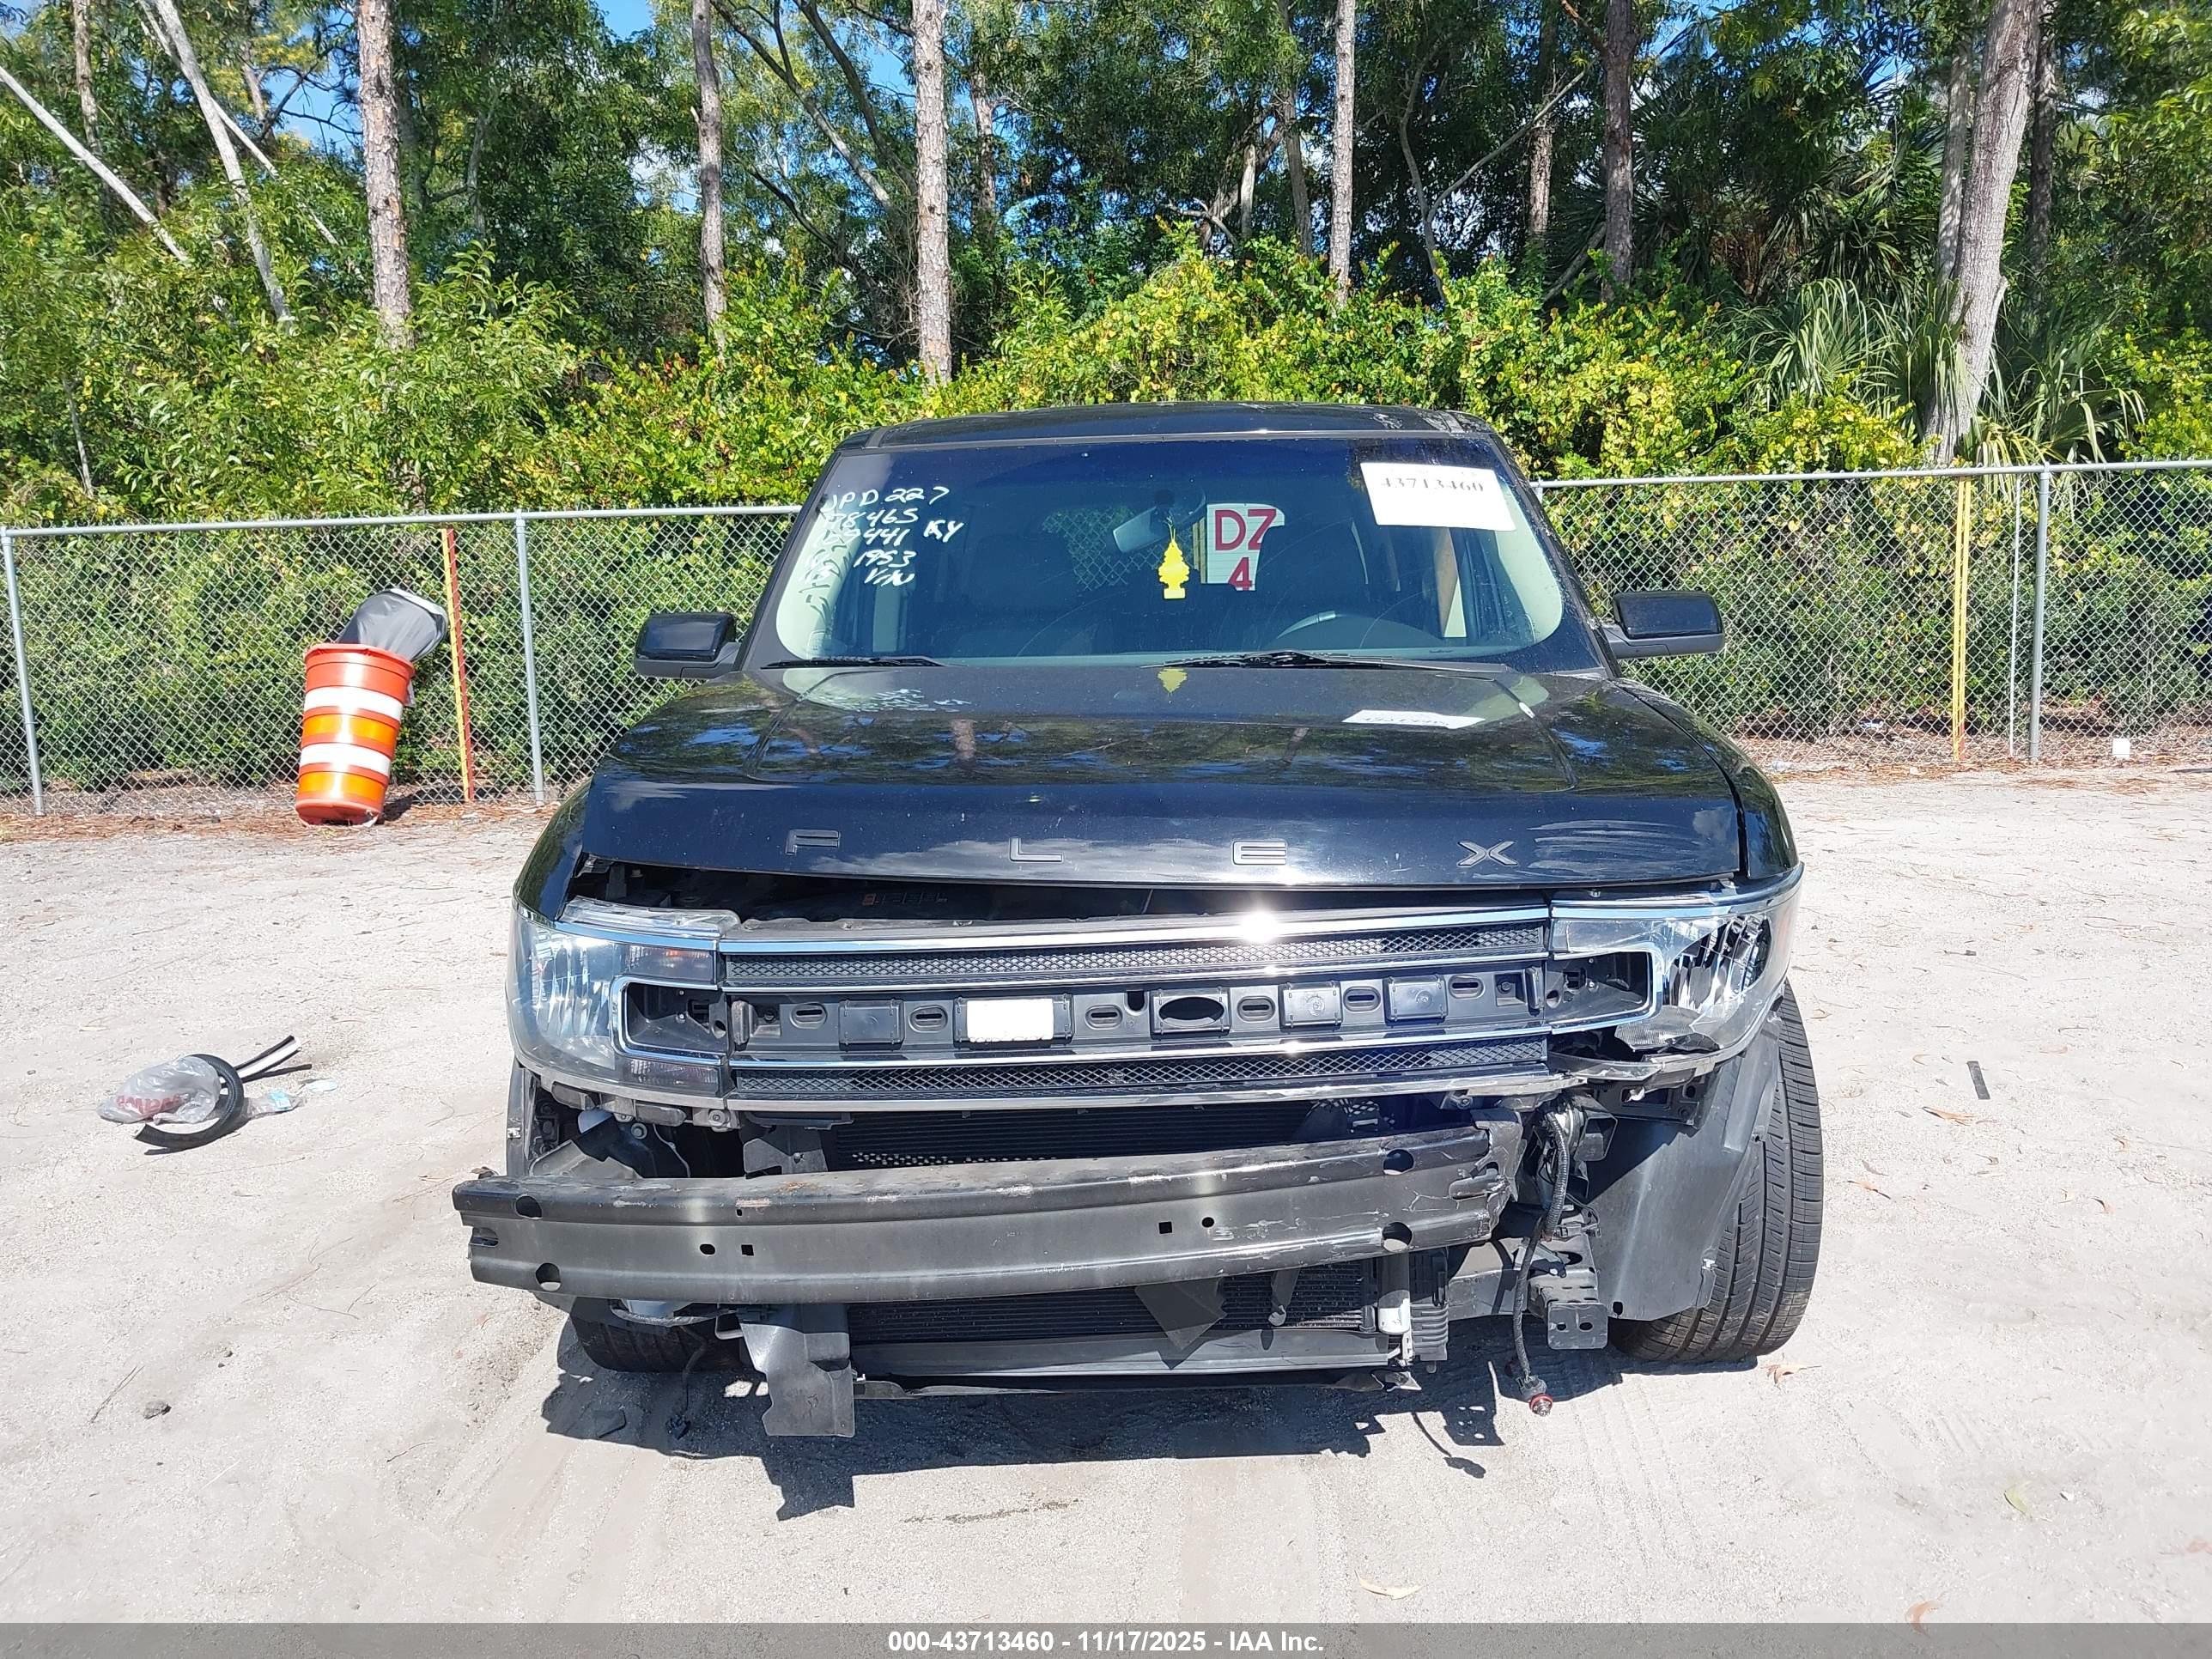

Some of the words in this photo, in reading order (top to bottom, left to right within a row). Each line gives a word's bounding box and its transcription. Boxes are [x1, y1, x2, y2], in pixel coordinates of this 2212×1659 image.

[1380, 477, 1485, 492] 43713460
[1228, 556, 1252, 591] 4
[785, 829, 1516, 868] FLEX
